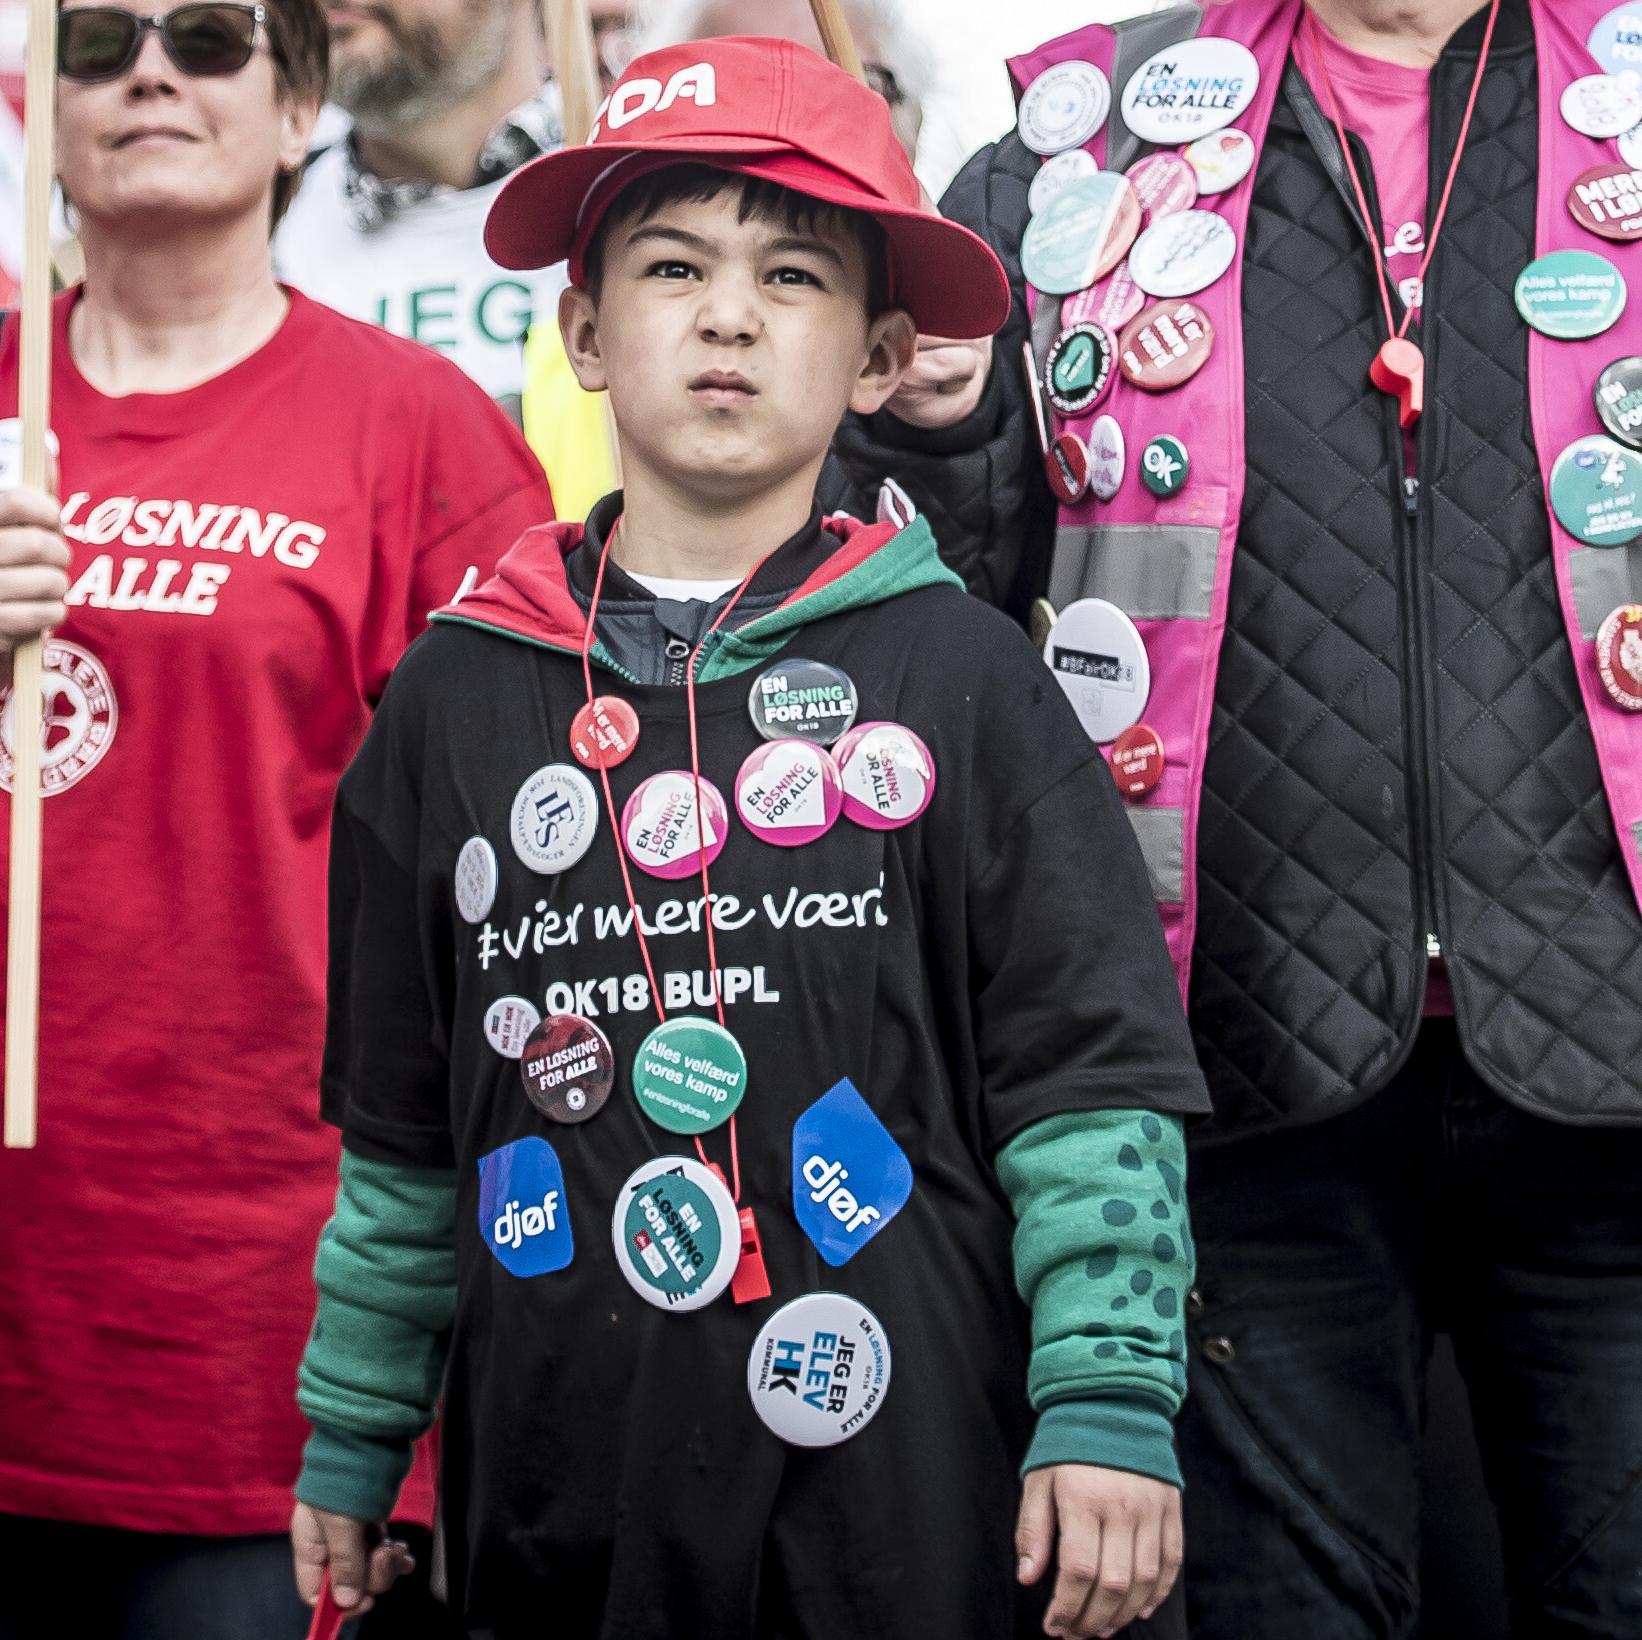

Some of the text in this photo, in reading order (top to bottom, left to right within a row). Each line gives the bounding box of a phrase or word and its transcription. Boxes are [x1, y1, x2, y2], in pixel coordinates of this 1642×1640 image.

[1138, 76, 1244, 94] LØSNING
[1146, 62, 1178, 76] EN
[1131, 93, 1239, 110] FOR ALLE
[1143, 443, 1184, 489] OK
[62, 554, 232, 616] ALLE
[760, 675, 789, 695] EN
[762, 685, 845, 708] LØSNING
[764, 699, 854, 725] FOR ALLE
[746, 786, 766, 807] EN
[755, 761, 806, 815] LØSNING
[766, 766, 820, 824] FOR ALLE
[880, 747, 902, 803] ØSNING
[533, 790, 575, 848] LFS
[635, 827, 652, 850] EN
[647, 791, 682, 855] LØSNING
[659, 791, 696, 860] FOR ALLE
[593, 893, 756, 937] mere
[544, 965, 781, 1018] OK18 BUPL
[527, 1057, 545, 1078] EN
[539, 1055, 599, 1091] FOR ALLE
[643, 1060, 729, 1104] vores kamp
[644, 1039, 741, 1087] Alles velfærd
[803, 1155, 881, 1233] djøf
[493, 1190, 559, 1249] djøf
[638, 1194, 697, 1283] FOR ALLE
[678, 1201, 703, 1234] EN
[858, 1318, 874, 1336] EN
[757, 1337, 775, 1392] KOMMUNAL
[767, 1339, 806, 1397] HK
[802, 1330, 838, 1412] ELEV
[826, 1335, 856, 1415] JEG ER
[839, 1408, 865, 1434] ALLE
[862, 1387, 880, 1412] FOR
